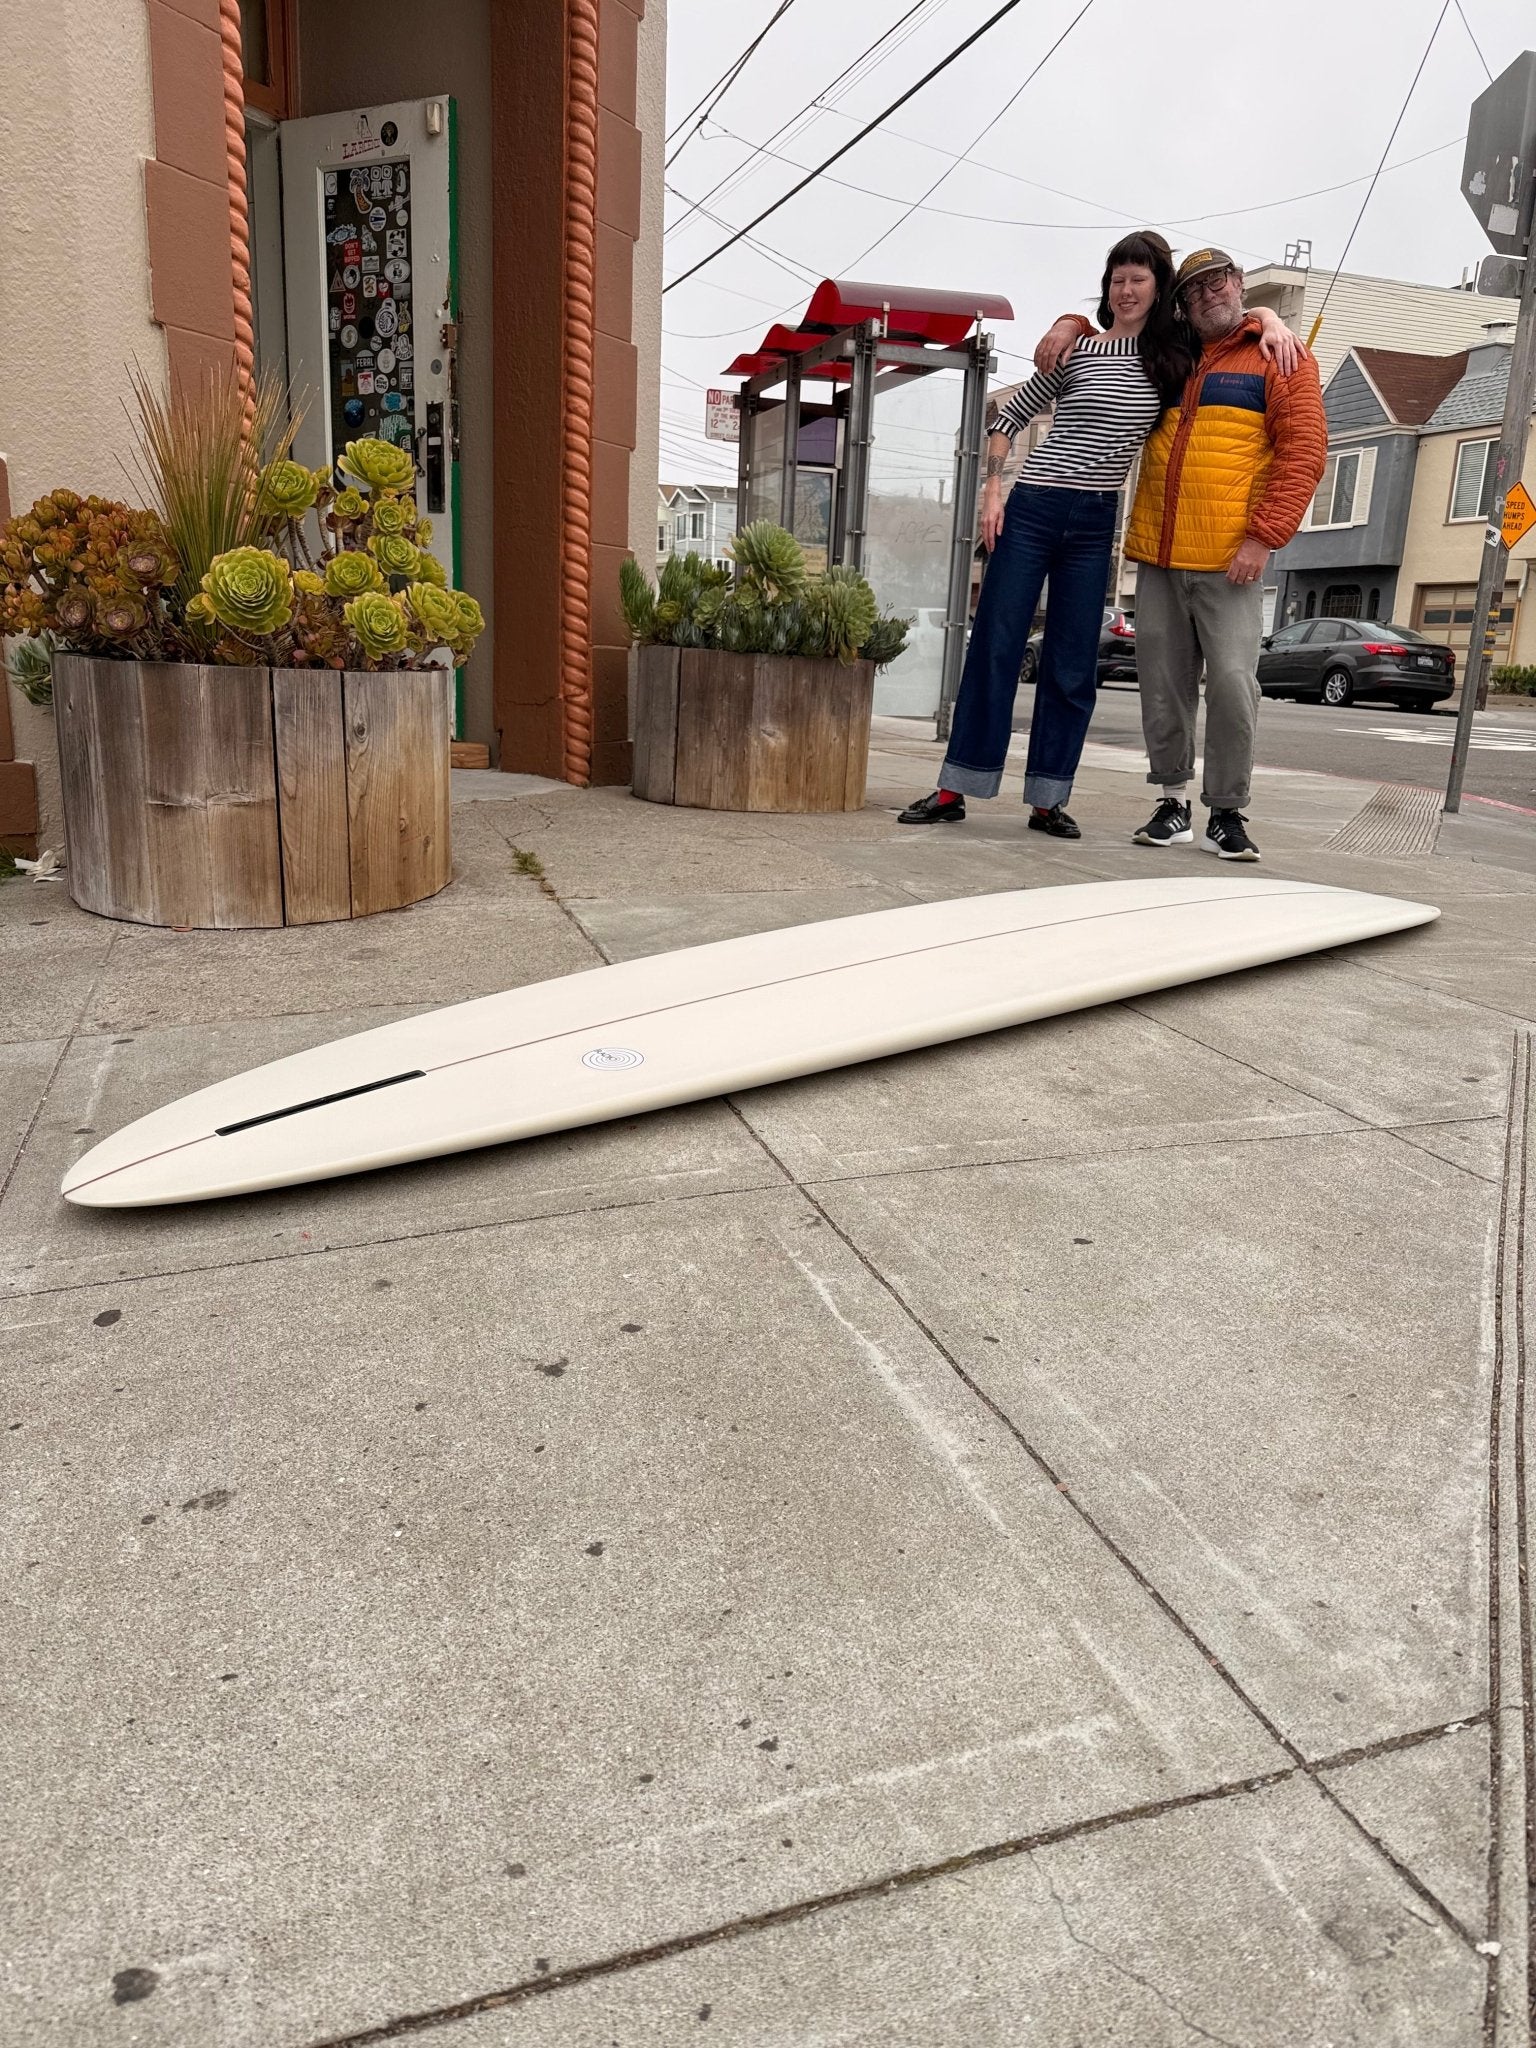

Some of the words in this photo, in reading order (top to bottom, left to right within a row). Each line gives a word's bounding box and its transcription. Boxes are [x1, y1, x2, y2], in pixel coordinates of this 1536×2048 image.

[356, 357, 374, 368] FERAL
[708, 390, 720, 404] NO
[710, 419, 719, 429] 12
[1506, 501, 1525, 510] SPEED
[1503, 512, 1525, 521] HUMPS
[1502, 522, 1523, 531] AHEAD
